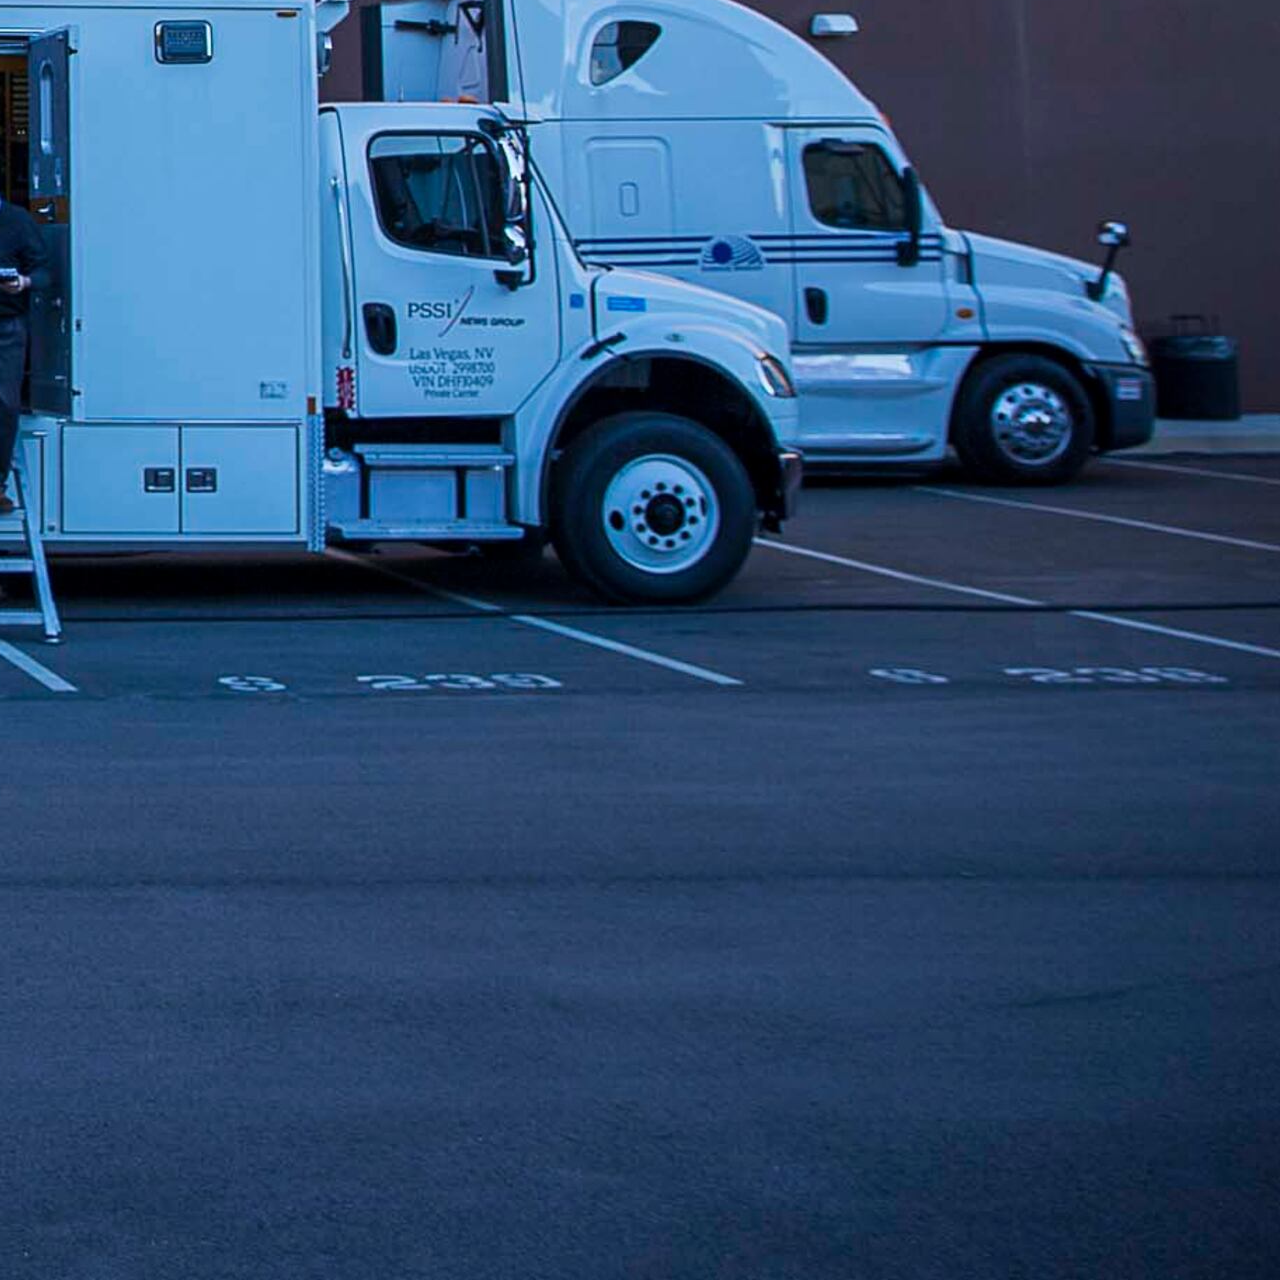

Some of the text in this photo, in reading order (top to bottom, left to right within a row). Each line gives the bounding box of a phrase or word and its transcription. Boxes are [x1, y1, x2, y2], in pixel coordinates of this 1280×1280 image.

[408, 302, 453, 319] PSSI
[460, 317, 525, 327] NEWS GROUP
[409, 348, 432, 361] Las
[474, 347, 494, 359] NV
[412, 376, 436, 388] VIN
